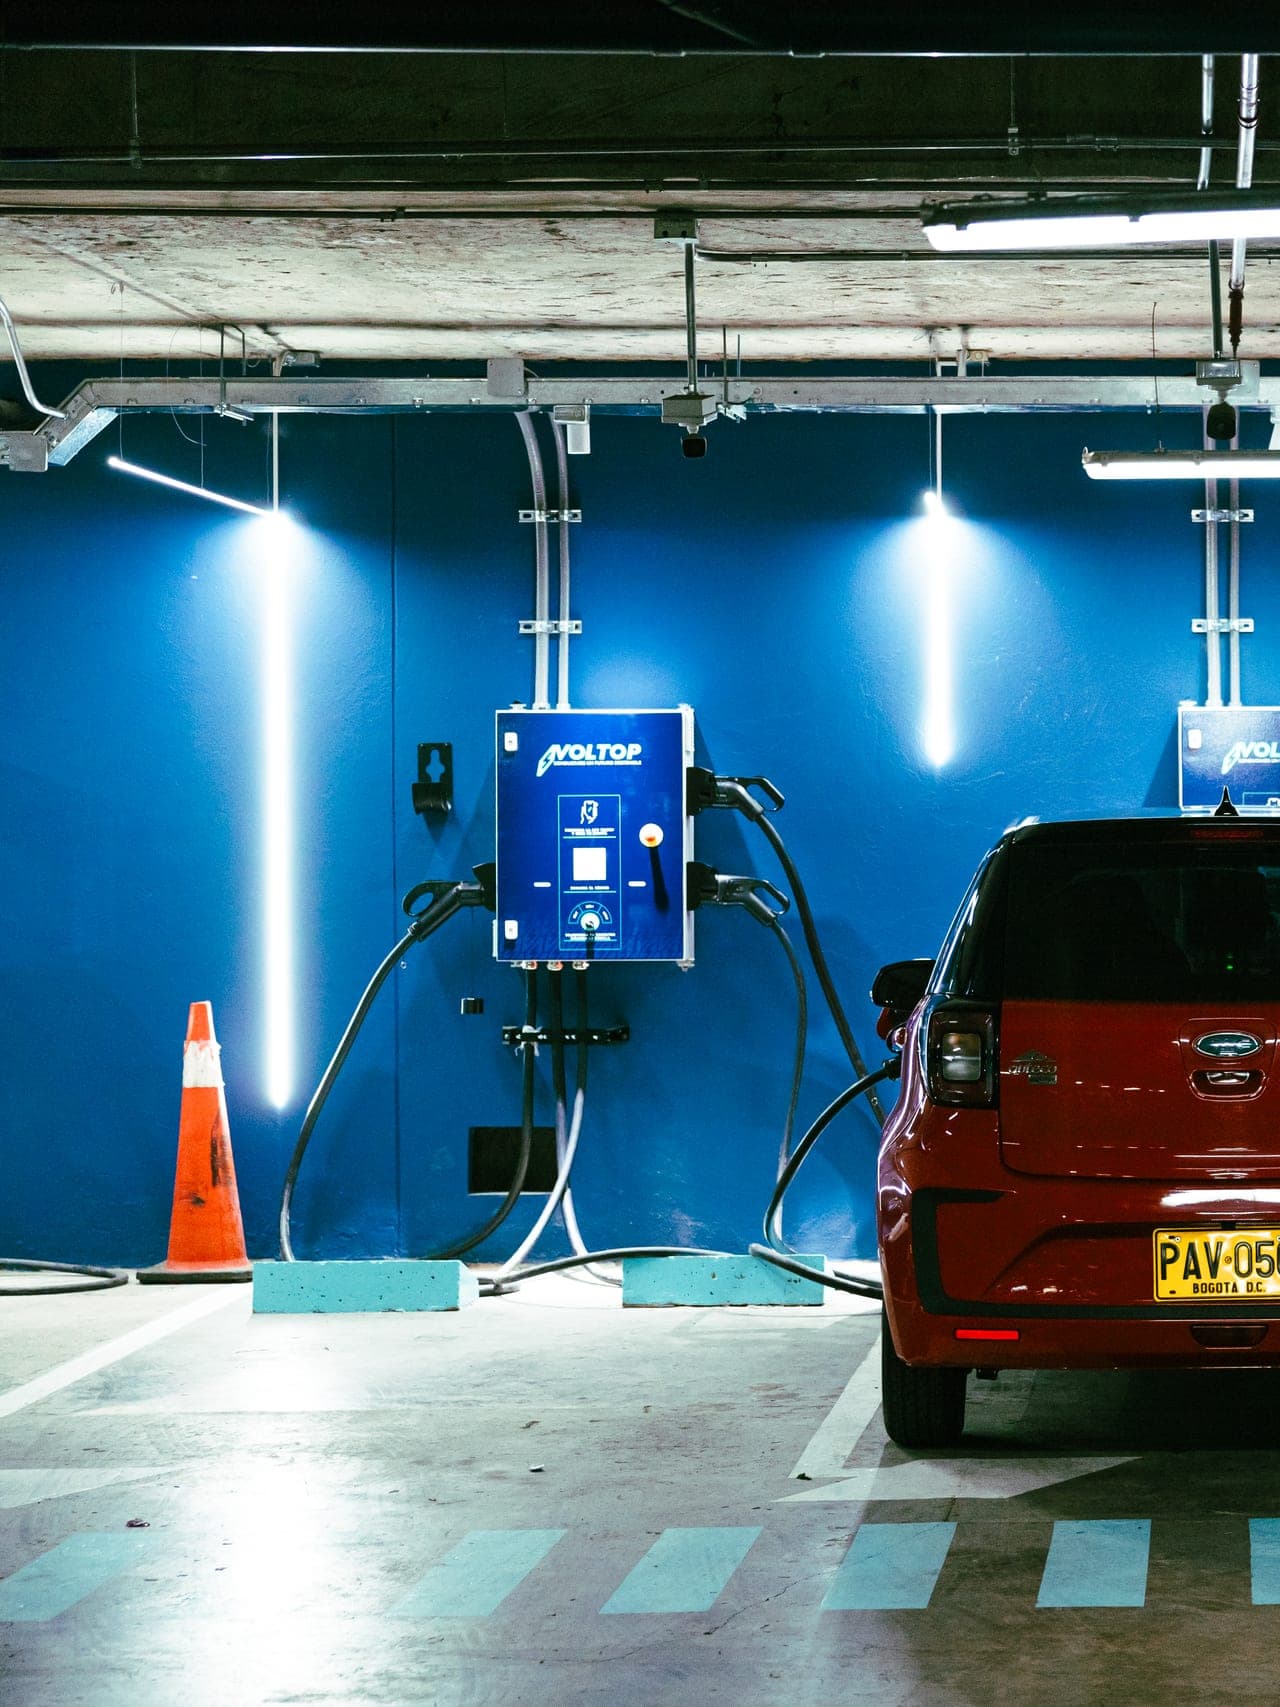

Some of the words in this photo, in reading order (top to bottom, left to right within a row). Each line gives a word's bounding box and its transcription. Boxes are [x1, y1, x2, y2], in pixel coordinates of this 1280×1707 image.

[554, 743, 642, 760] VOLTOP
[1160, 1240, 1223, 1280] PAV
[1192, 1281, 1238, 1294] BOGOTA
[1246, 1281, 1266, 1293] D.C.
